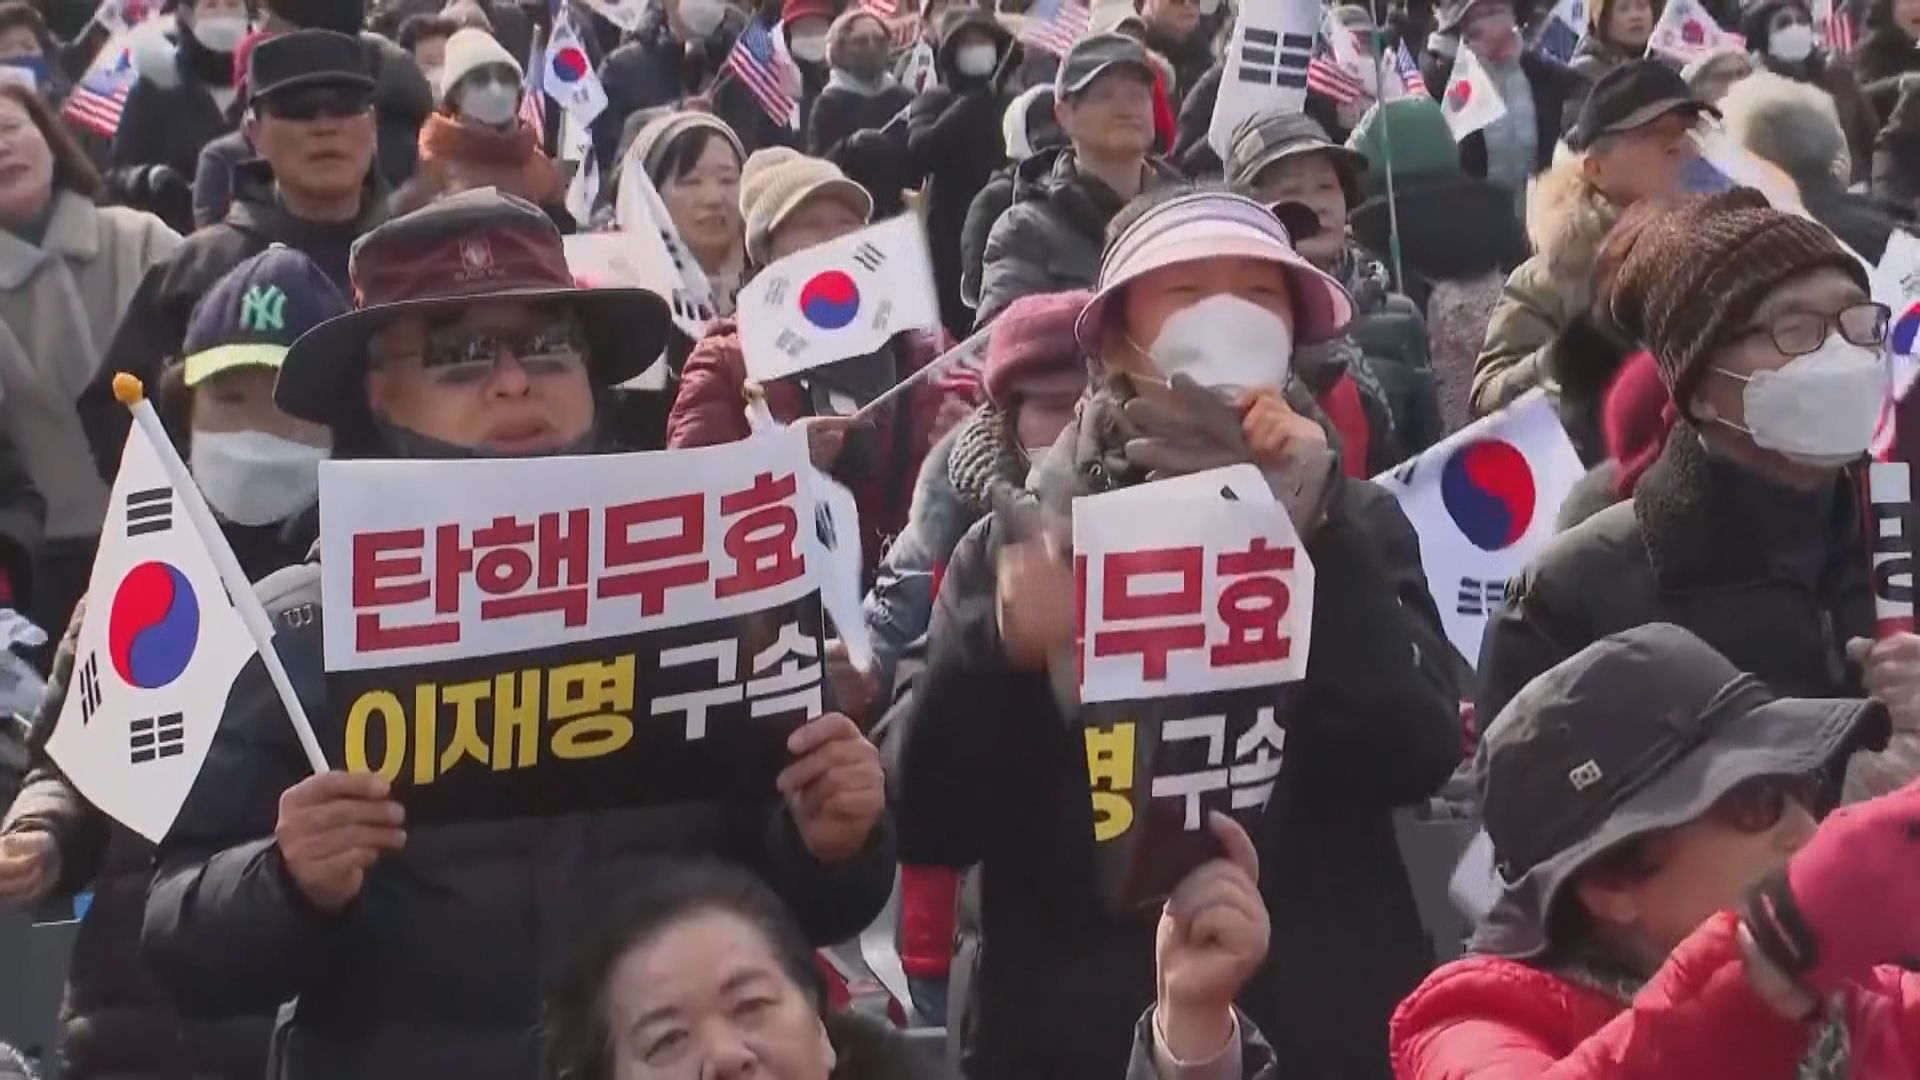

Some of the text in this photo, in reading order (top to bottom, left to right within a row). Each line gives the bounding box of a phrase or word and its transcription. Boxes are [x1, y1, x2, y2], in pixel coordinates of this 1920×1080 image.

[240, 284, 288, 331] NY
[352, 471, 806, 653] 탄핵무효
[1075, 537, 1296, 684] 무효
[344, 620, 823, 786] 이재명 구속
[1152, 706, 1286, 832] 구속
